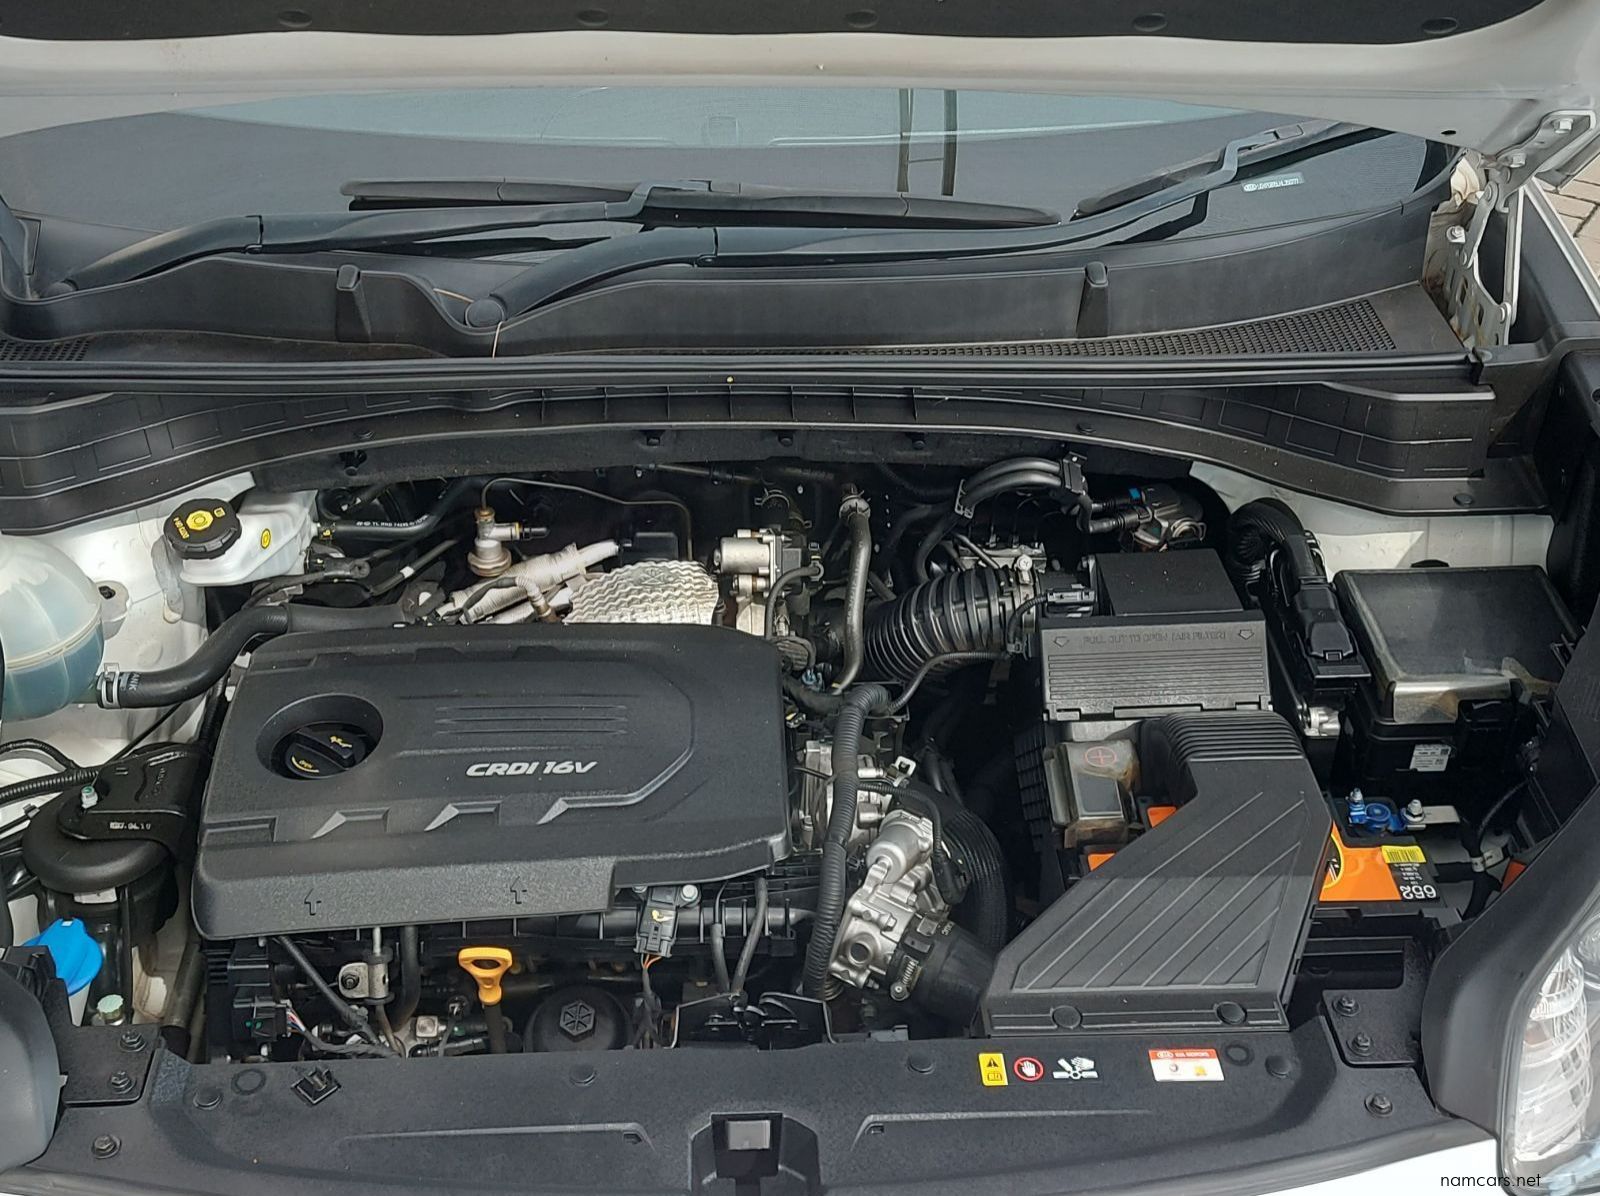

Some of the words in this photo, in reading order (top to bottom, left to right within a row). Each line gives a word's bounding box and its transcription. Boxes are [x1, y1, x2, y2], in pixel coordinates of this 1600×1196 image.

[465, 761, 540, 777] CRDI
[542, 760, 599, 774] 16V
[1400, 884, 1438, 900] 652
